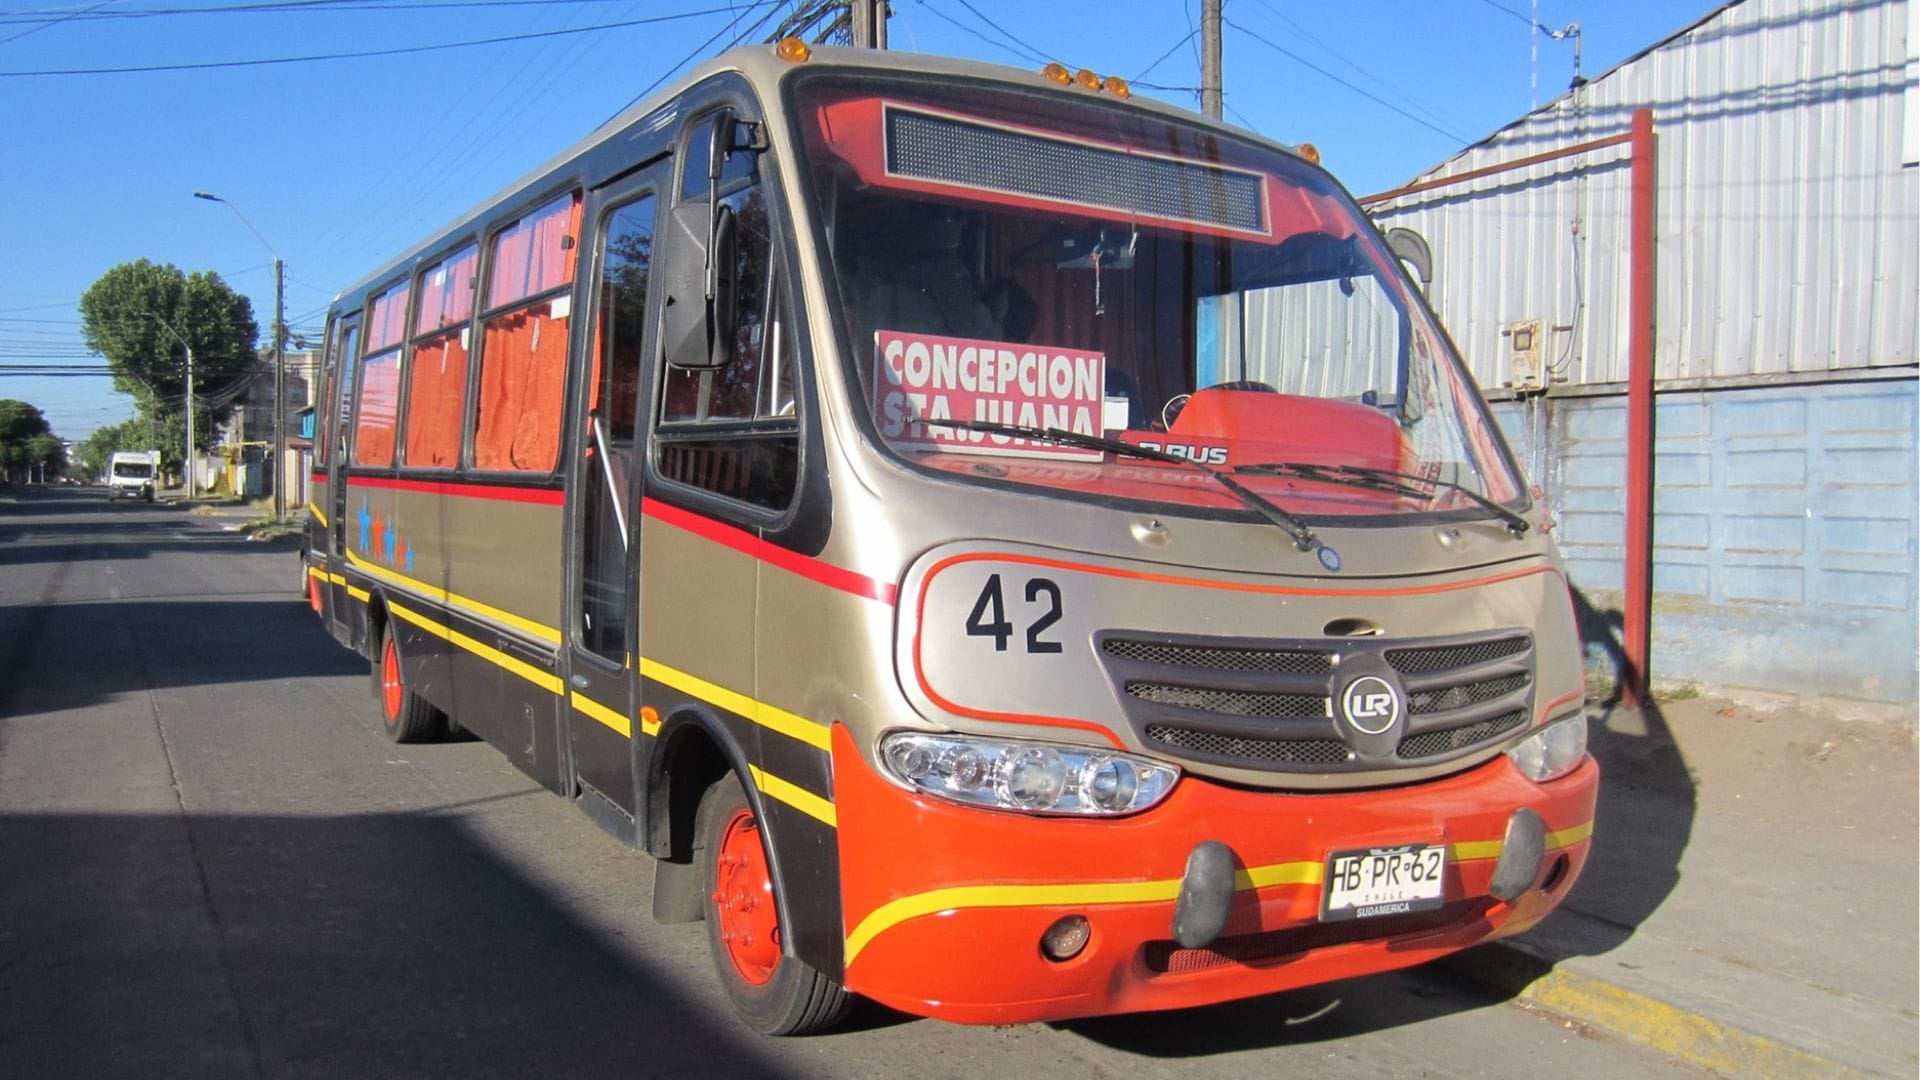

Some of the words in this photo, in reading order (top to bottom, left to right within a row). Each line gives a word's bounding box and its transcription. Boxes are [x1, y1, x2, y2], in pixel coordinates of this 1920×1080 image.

[884, 340, 1097, 401] CONCEPCION
[966, 574, 1063, 654] 42
[1353, 693, 1391, 717] LR
[1365, 891, 1402, 902] CHILE
[1357, 902, 1410, 918] SUDAMERICA
